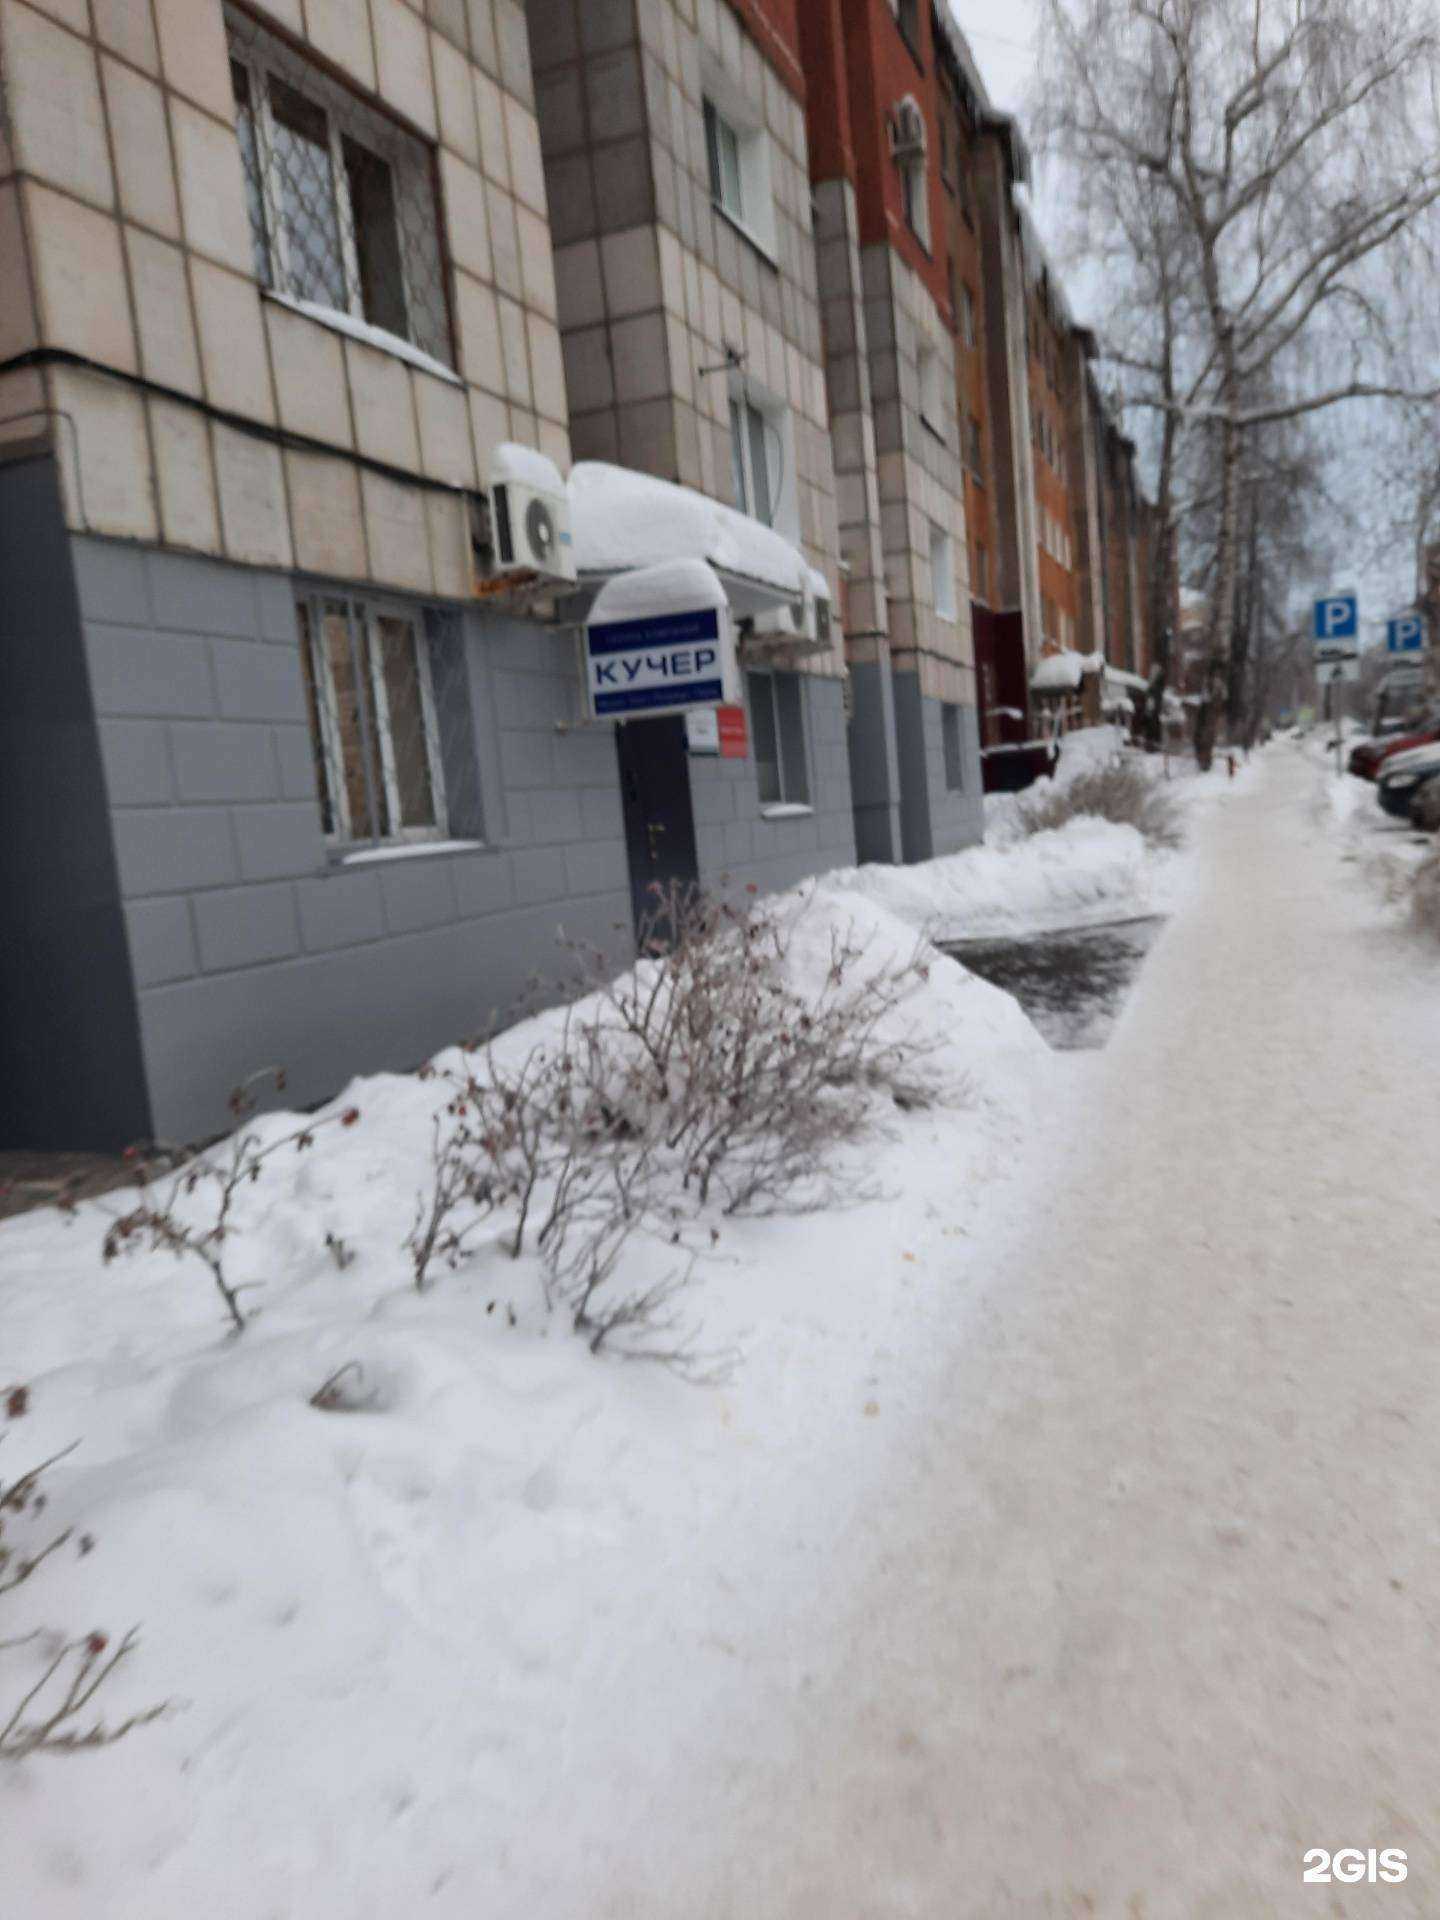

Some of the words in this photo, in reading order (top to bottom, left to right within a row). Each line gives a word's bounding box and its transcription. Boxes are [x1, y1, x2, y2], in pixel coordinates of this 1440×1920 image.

[1325, 603, 1351, 636] P
[1395, 620, 1418, 649] P
[595, 648, 716, 685] КУЧЕР
